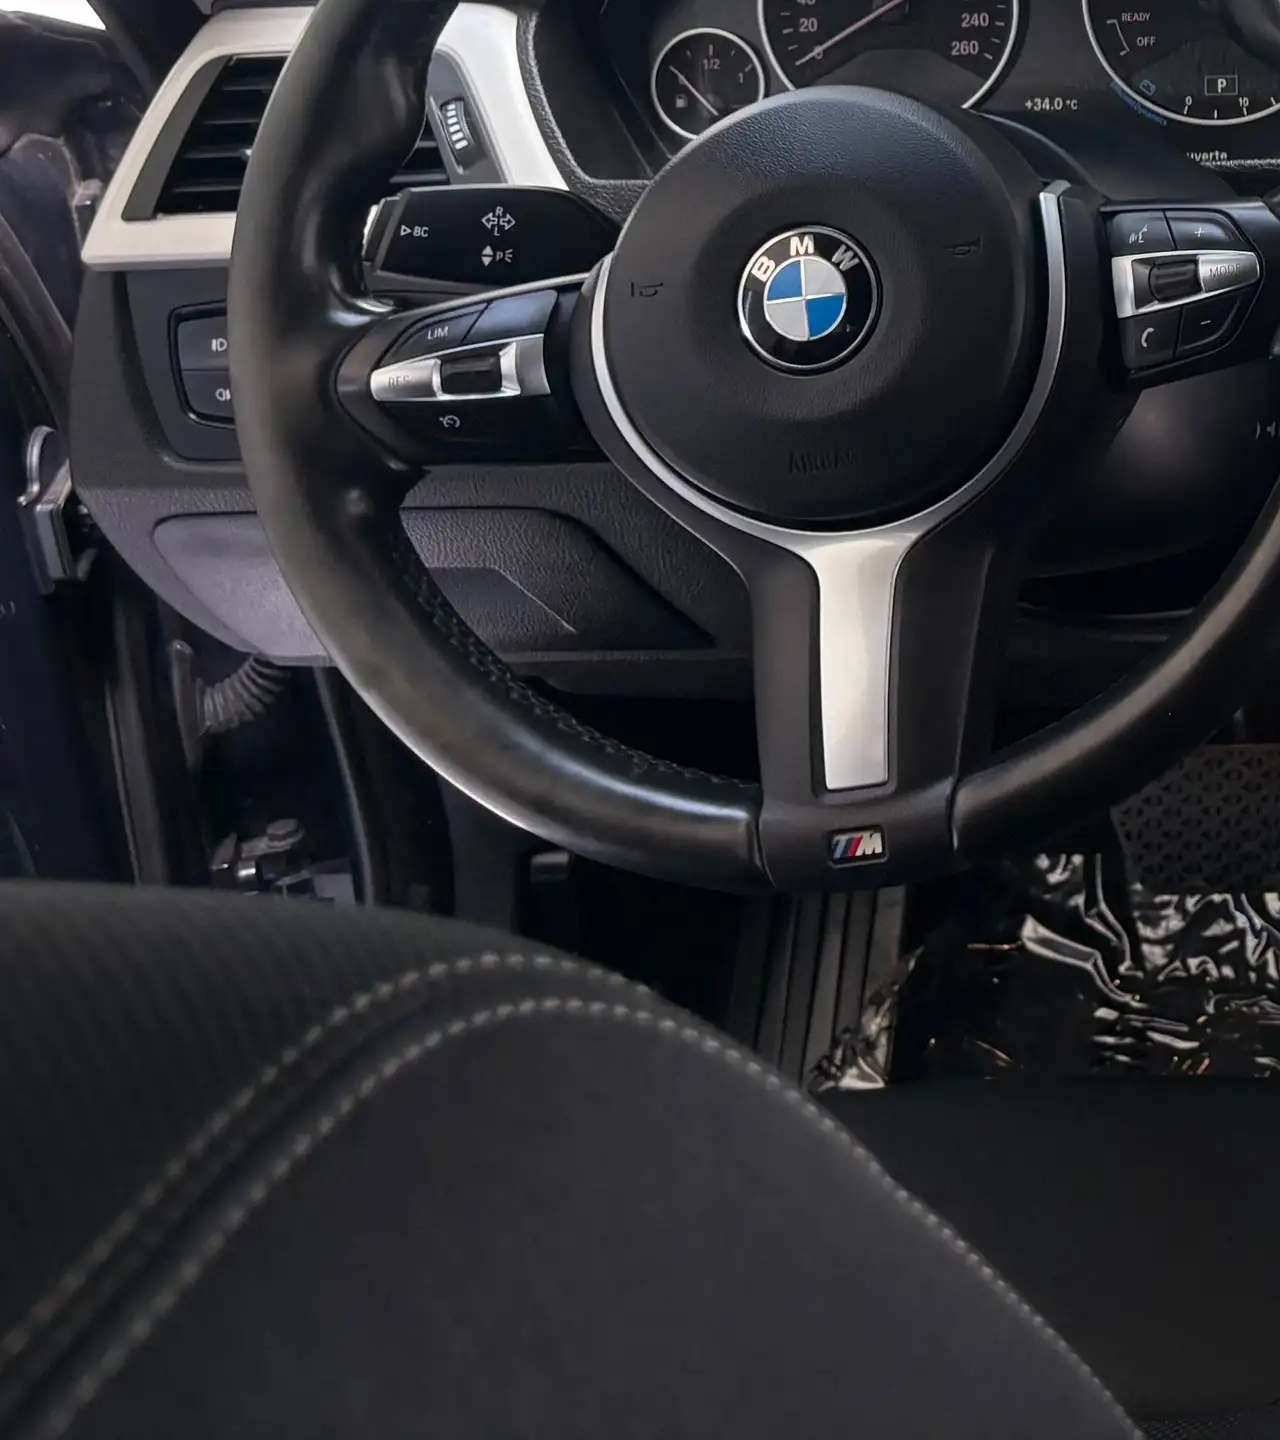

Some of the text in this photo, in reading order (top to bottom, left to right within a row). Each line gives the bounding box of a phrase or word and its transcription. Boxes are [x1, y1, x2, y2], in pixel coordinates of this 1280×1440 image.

[961, 13, 990, 27] 240
[1121, 12, 1151, 22] READY
[799, 18, 818, 32] 20
[951, 41, 979, 55] 260
[1136, 36, 1156, 47] OFF
[703, 58, 720, 70] 1/2
[738, 72, 744, 83] 1
[1217, 78, 1227, 93] P
[1025, 98, 1077, 111] +34.0 °C
[1185, 96, 1192, 106] 0
[1238, 97, 1249, 107] 10
[413, 226, 429, 238] BC
[751, 234, 859, 284] BMW
[1208, 263, 1241, 278] MODE
[427, 326, 449, 340] LIM
[388, 375, 411, 388] RES
